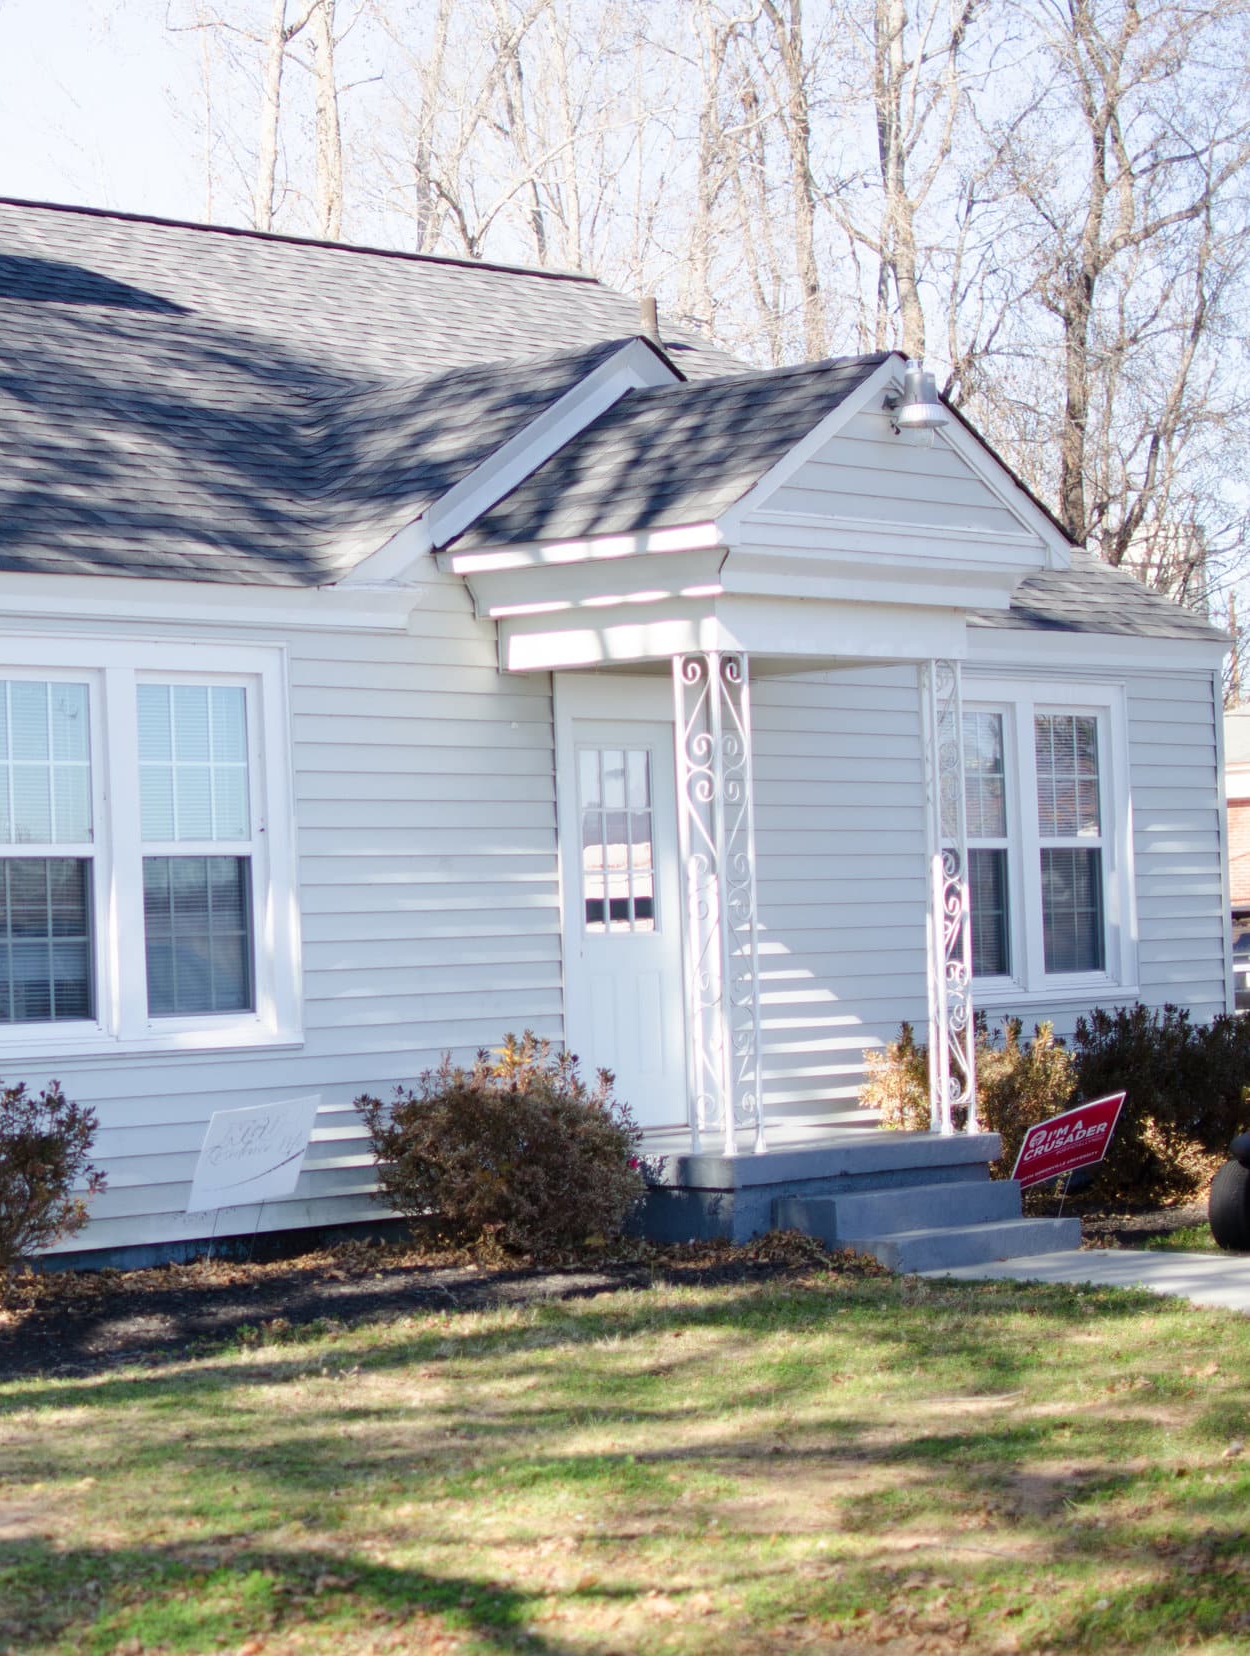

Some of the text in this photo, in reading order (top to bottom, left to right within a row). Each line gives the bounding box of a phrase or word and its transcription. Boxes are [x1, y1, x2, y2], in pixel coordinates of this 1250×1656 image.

[1023, 1121, 1108, 1161] CRUSADER
[1047, 1120, 1083, 1142] I'M A
